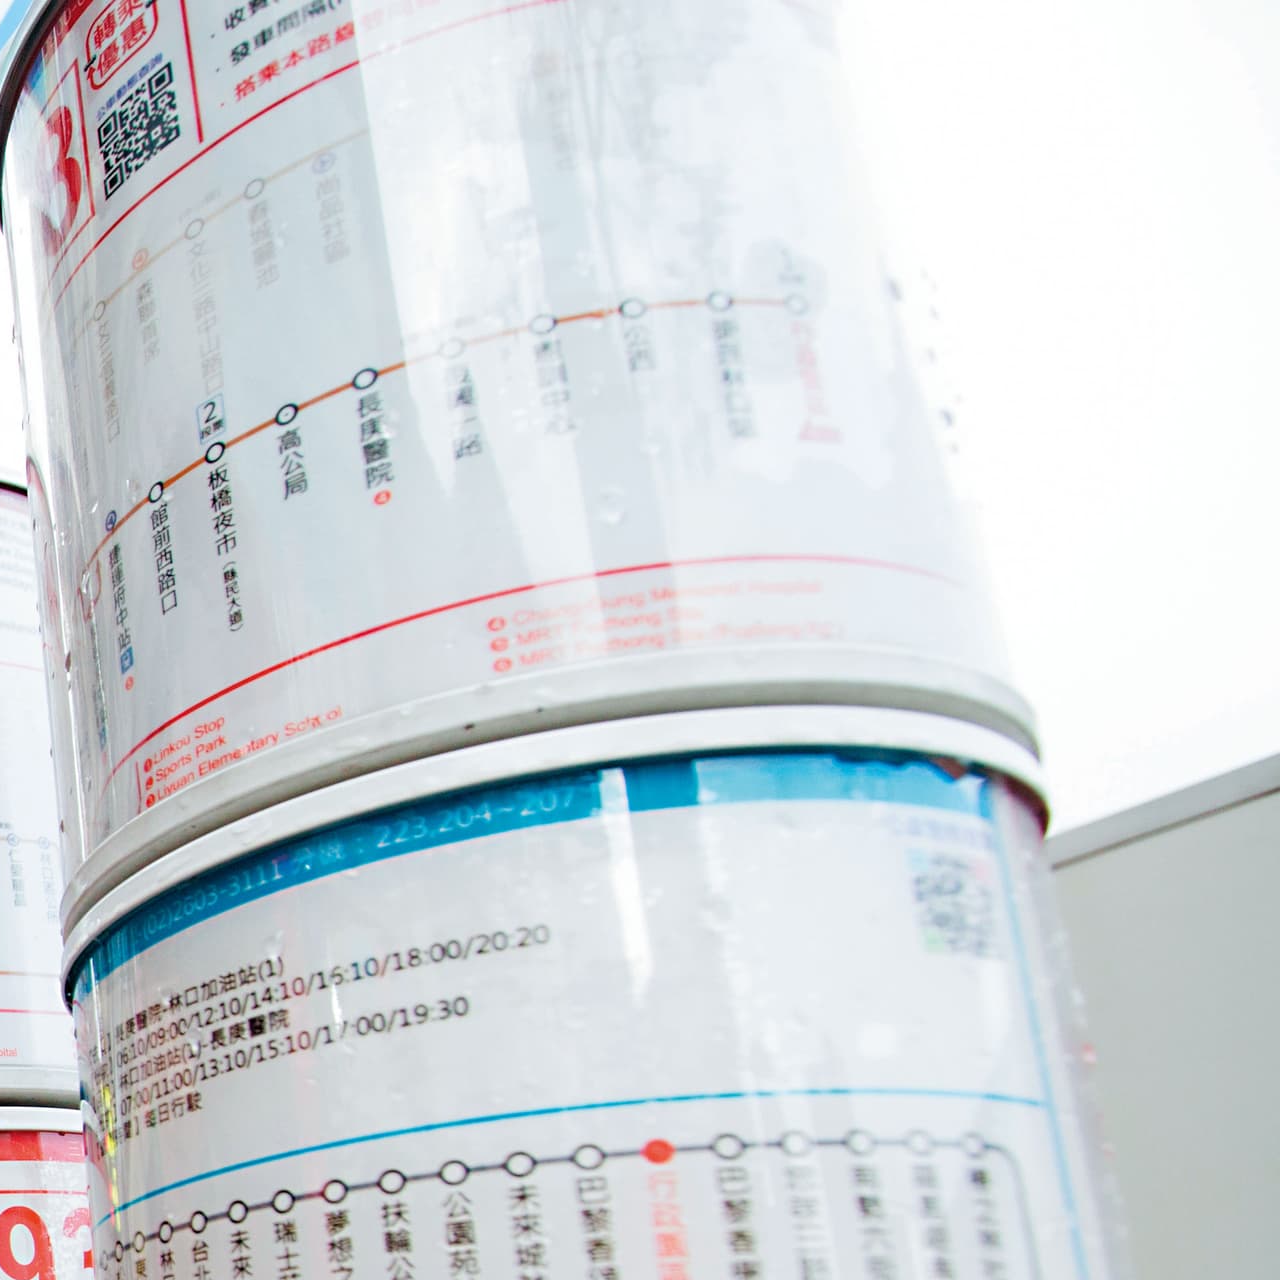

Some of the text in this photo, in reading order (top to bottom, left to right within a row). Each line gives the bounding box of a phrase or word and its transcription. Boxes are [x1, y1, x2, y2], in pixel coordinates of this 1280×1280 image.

[203, 400, 217, 425] 2
[276, 426, 308, 501] 高公局
[151, 502, 178, 616] 館前西路口
[153, 716, 225, 765] Linkou Stop
[155, 735, 227, 783] Sports Park
[198, 732, 280, 777] Elementary
